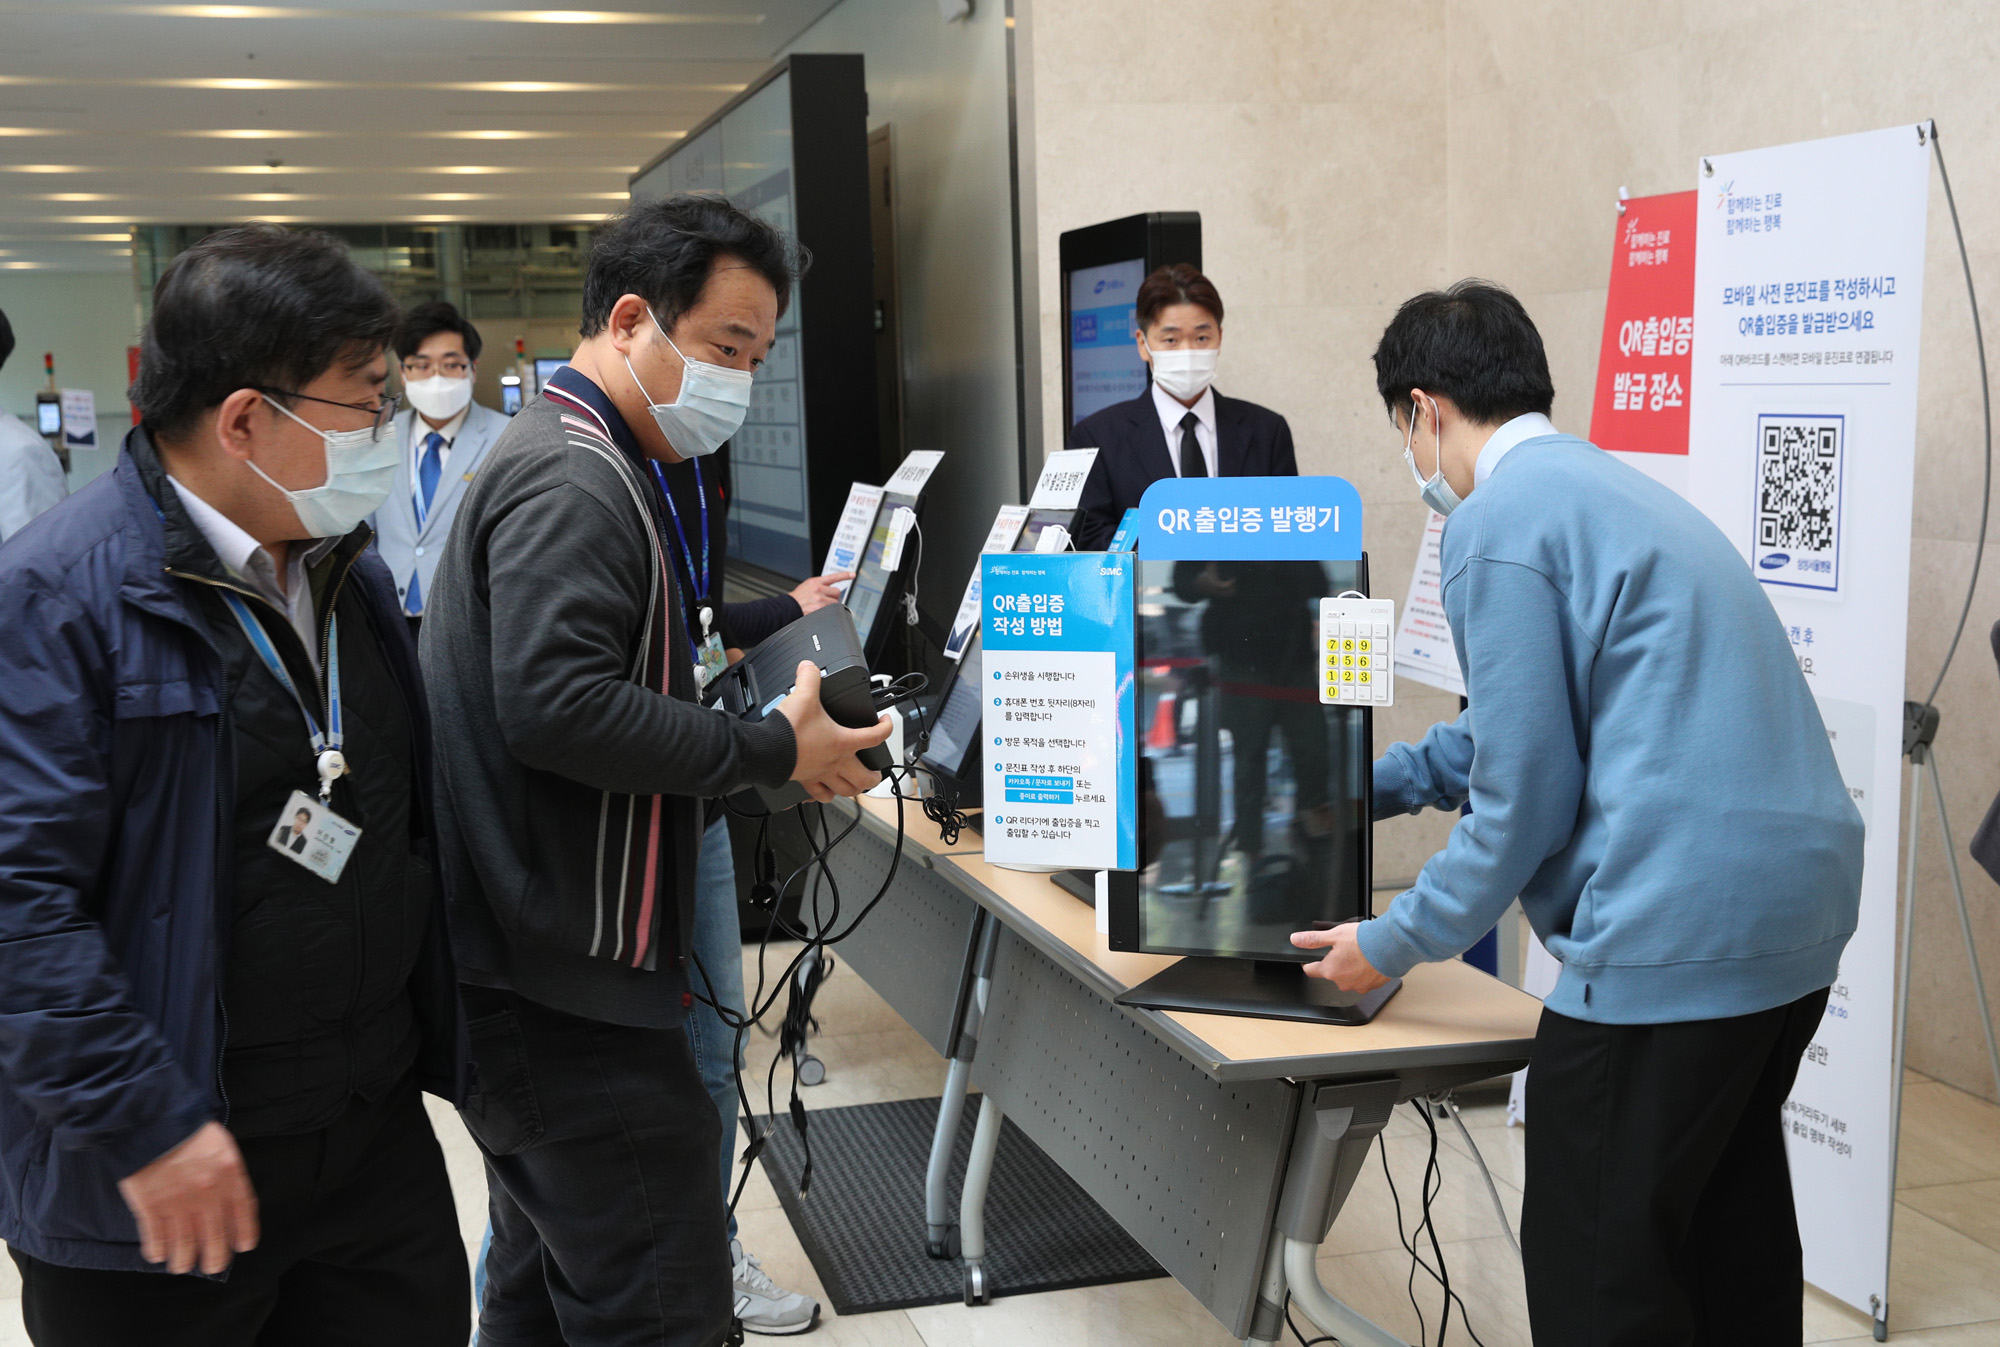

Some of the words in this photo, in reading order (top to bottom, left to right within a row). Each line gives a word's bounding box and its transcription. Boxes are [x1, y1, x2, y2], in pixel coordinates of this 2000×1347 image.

[1722, 284, 1756, 306] 모바일
[1758, 283, 1781, 305] 사전
[1783, 280, 1830, 304] 문진표를
[1833, 276, 1896, 301] 작성하시고
[1738, 314, 1799, 337] QR출입증을
[1802, 310, 1875, 335] 발급받으세요
[1618, 316, 1693, 357] QR출입증
[1613, 372, 1647, 411] 발급
[1649, 372, 1683, 412] 장소
[1270, 505, 1340, 533] 발행기
[992, 593, 1065, 613] QR출입증
[993, 616, 1025, 636] 작성
[1030, 616, 1062, 636] 방법
[1803, 627, 1814, 647] 후
[1329, 639, 1336, 650] 7
[1344, 640, 1352, 650] 8
[1360, 640, 1368, 650] 9
[1329, 656, 1335, 665] 4
[1345, 655, 1351, 665] 5
[1360, 656, 1367, 666] 6
[1004, 671, 1035, 681] 손위생을
[1038, 672, 1075, 682] 시행합니다
[1329, 671, 1335, 680] 1
[1344, 671, 1351, 681] 2
[1361, 671, 1368, 682] 3
[1329, 686, 1335, 697] 0
[1005, 697, 1027, 707] 휴대폰
[1030, 698, 1045, 707] 번호
[1015, 711, 1052, 722] 입력합니다
[1005, 737, 1020, 747] 방문
[1023, 737, 1045, 748] 목적을
[1047, 738, 1086, 748] 선택합니다
[1005, 763, 1028, 773] 문진표
[1030, 764, 1045, 774] 작성
[1048, 765, 1055, 773] 후
[1058, 765, 1081, 775] 하단의
[1076, 780, 1092, 789] 또는
[1075, 794, 1106, 803] 누르세요
[1005, 816, 1018, 825] QR
[1020, 816, 1050, 826] 리더기에
[1052, 818, 1082, 828] 출입증을
[1084, 819, 1101, 829] 찍고
[1006, 828, 1029, 838] 출입할
[1031, 829, 1039, 838] 수
[1041, 829, 1071, 839] 있습니다
